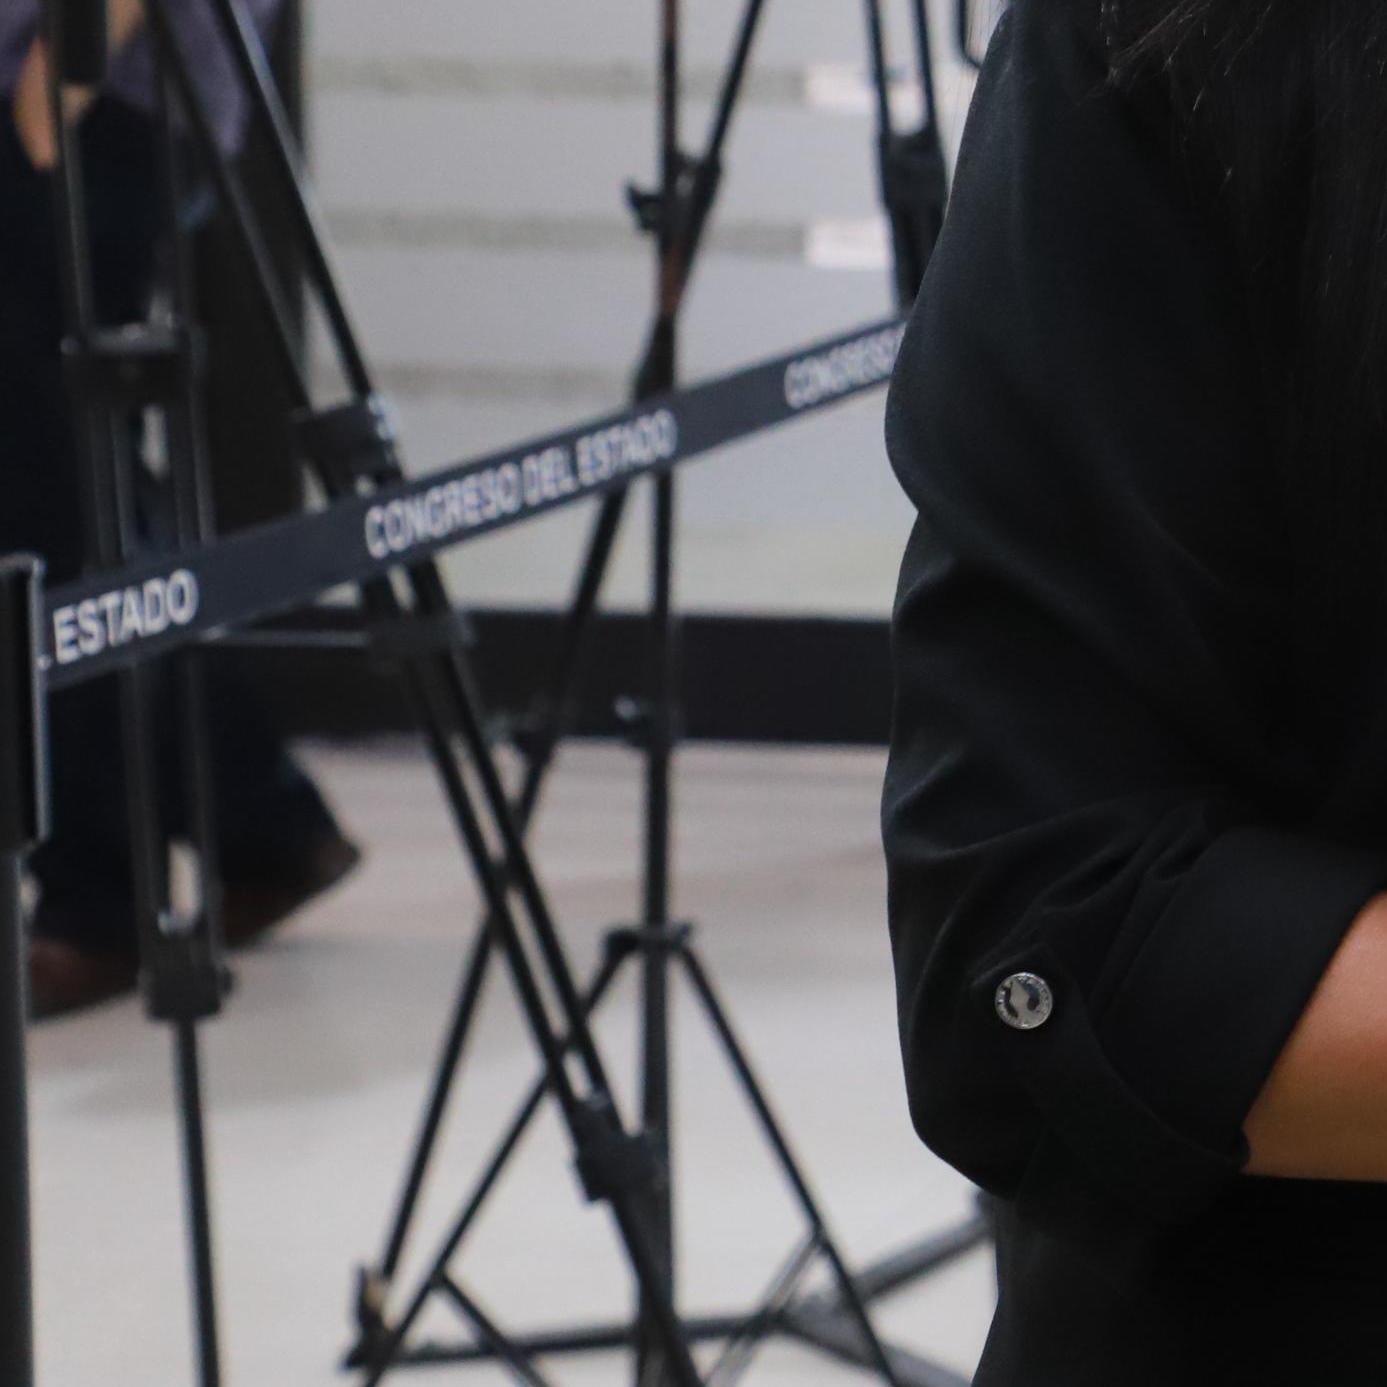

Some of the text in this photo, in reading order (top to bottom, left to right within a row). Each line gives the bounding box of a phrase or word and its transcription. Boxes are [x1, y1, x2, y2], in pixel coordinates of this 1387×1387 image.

[365, 409, 677, 558] CONGRESO DEL ESTADO
[53, 568, 199, 664] ESTADO
